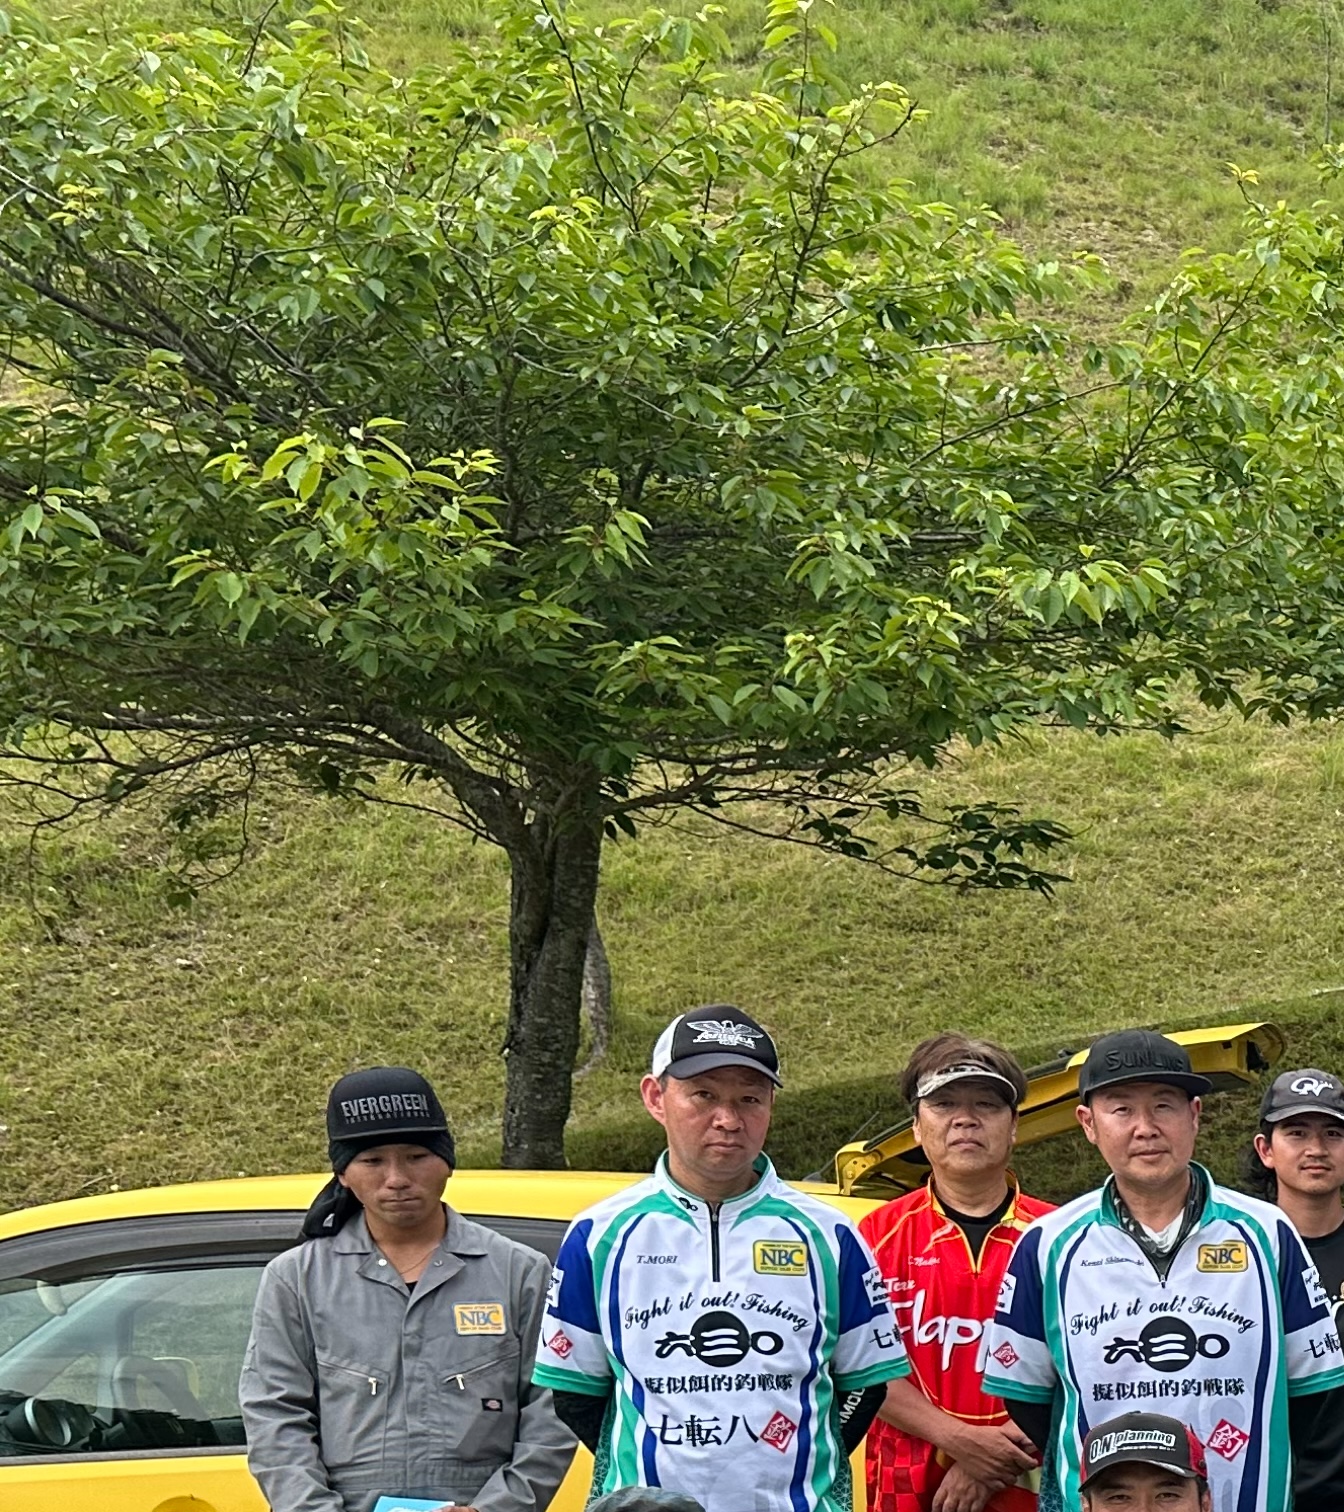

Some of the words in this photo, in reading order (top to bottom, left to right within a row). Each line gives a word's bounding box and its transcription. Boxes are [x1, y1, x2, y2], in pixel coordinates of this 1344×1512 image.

[341, 1094, 429, 1117] EVERGREEN
[636, 1254, 678, 1265] T.MORI
[760, 1248, 804, 1267] NBC
[1204, 1250, 1242, 1265] NBC
[459, 1310, 502, 1326] NBC
[624, 1299, 673, 1330] Fight
[679, 1292, 695, 1312] it
[701, 1291, 740, 1308] out!
[740, 1293, 812, 1332] Fishing
[1071, 1302, 1119, 1336] Fight
[1127, 1297, 1143, 1315] it
[1150, 1296, 1185, 1313] out!
[1189, 1296, 1258, 1332] Fishing
[1116, 1430, 1176, 1447] planning
[1206, 1418, 1249, 1461] 釣
